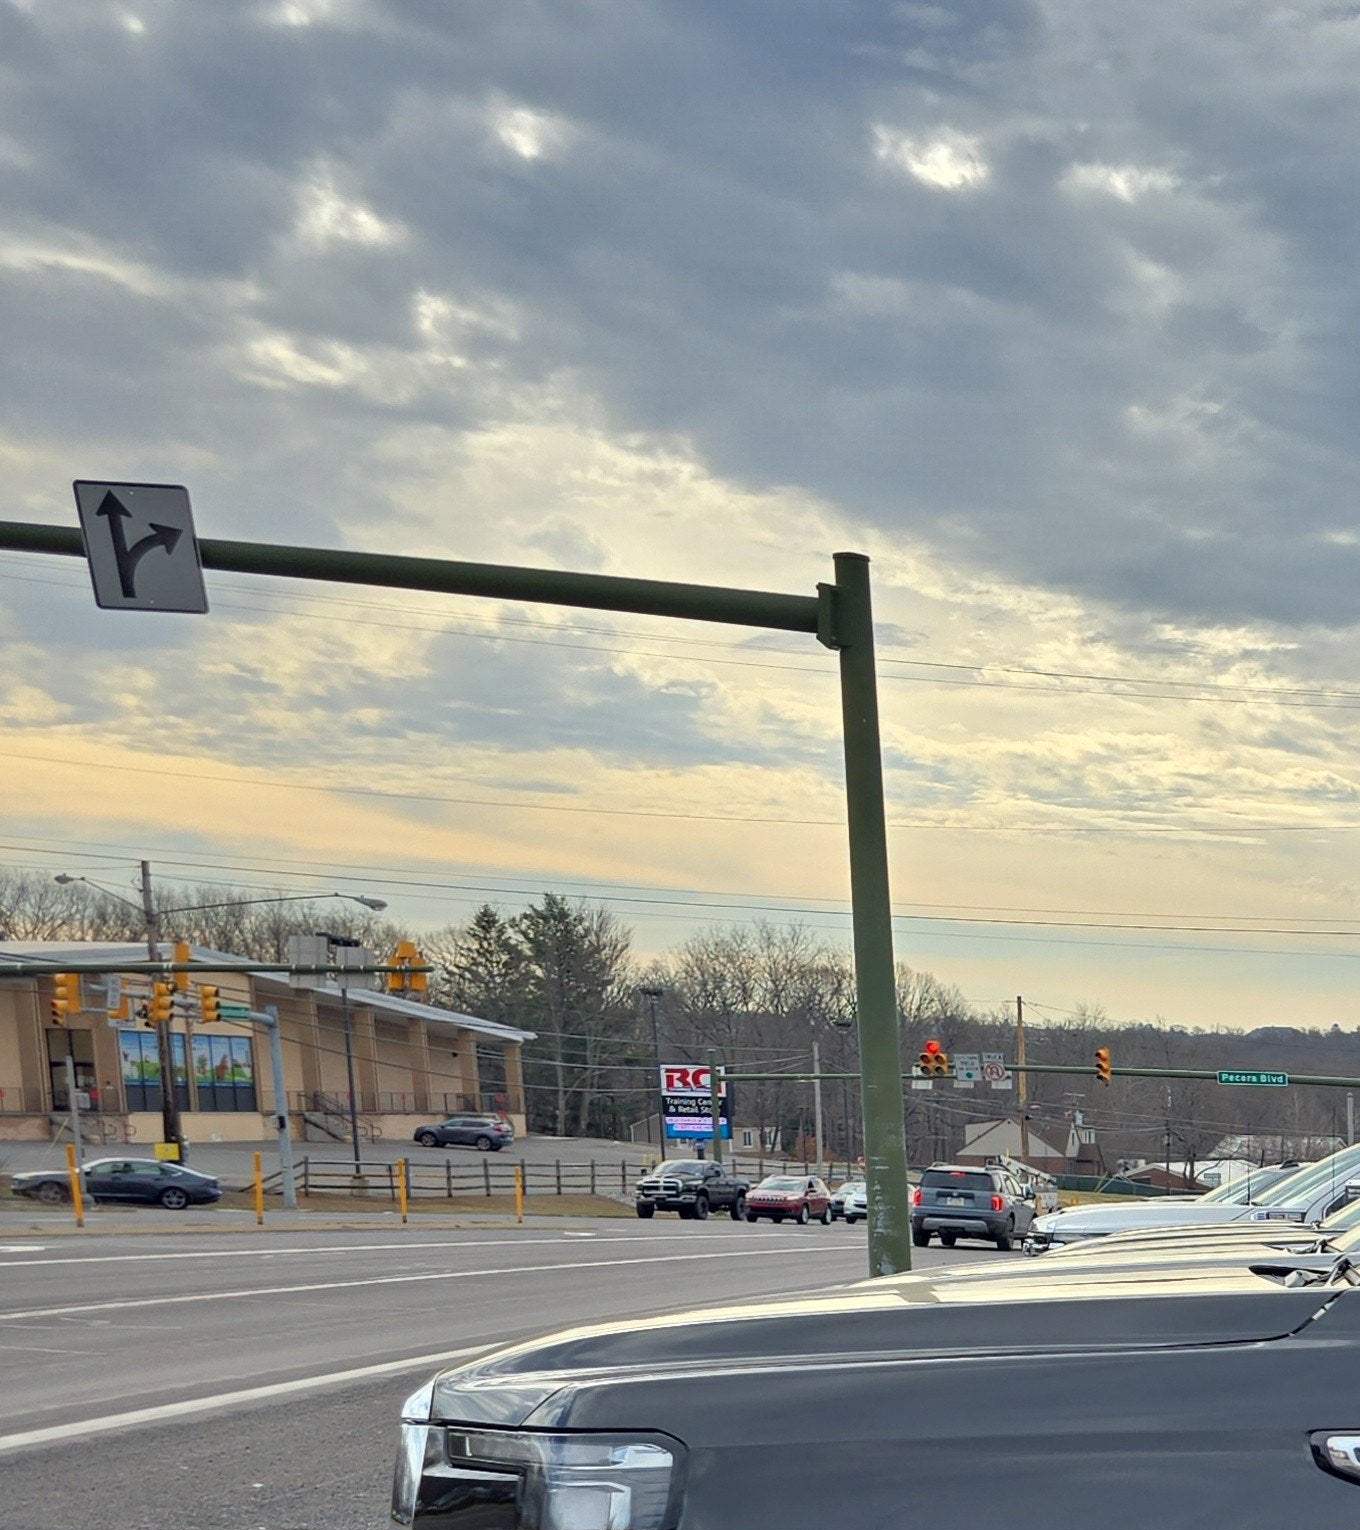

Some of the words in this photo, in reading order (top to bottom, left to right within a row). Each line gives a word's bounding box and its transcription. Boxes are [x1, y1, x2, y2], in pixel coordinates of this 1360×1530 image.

[1221, 1073, 1257, 1082] Pecora
[1260, 1074, 1284, 1083] Blvd
[665, 1097, 697, 1107] Training
[697, 1098, 723, 1106] Cenr
